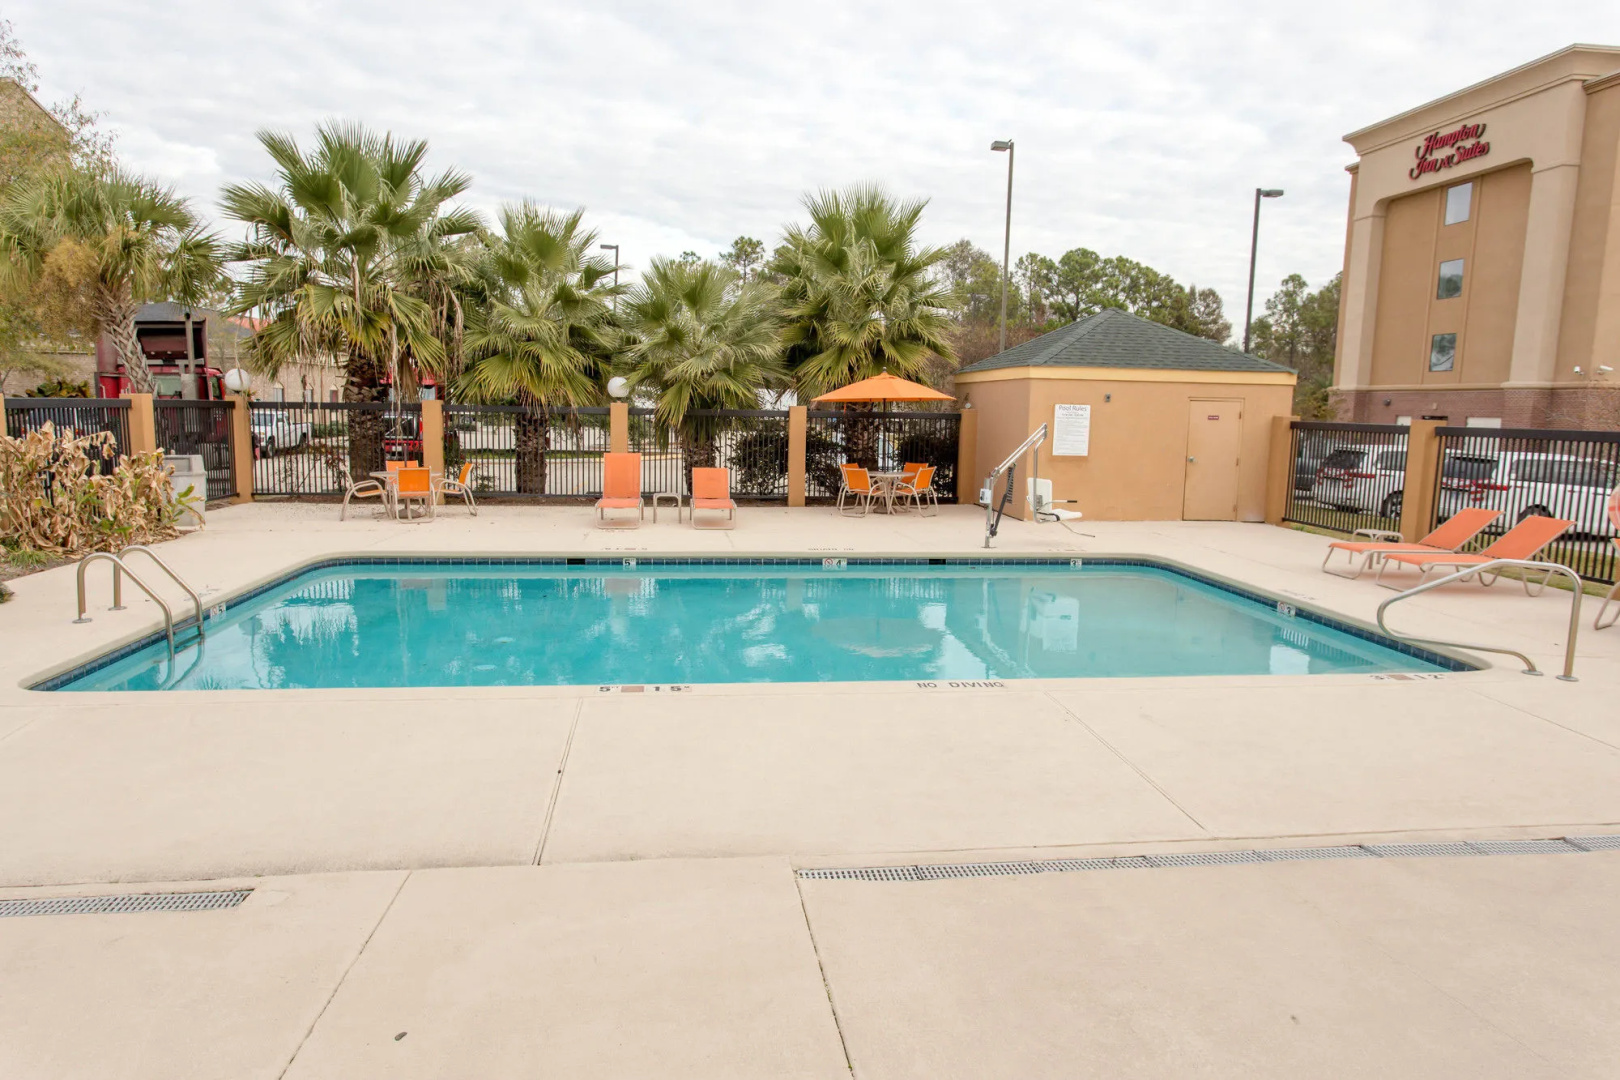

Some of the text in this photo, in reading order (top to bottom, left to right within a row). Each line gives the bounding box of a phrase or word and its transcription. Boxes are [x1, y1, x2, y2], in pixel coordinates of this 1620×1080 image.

[1415, 123, 1487, 160] Hampton
[1408, 157, 1442, 181] Inn
[1453, 140, 1491, 166] Suites
[1058, 404, 1072, 412] Pool
